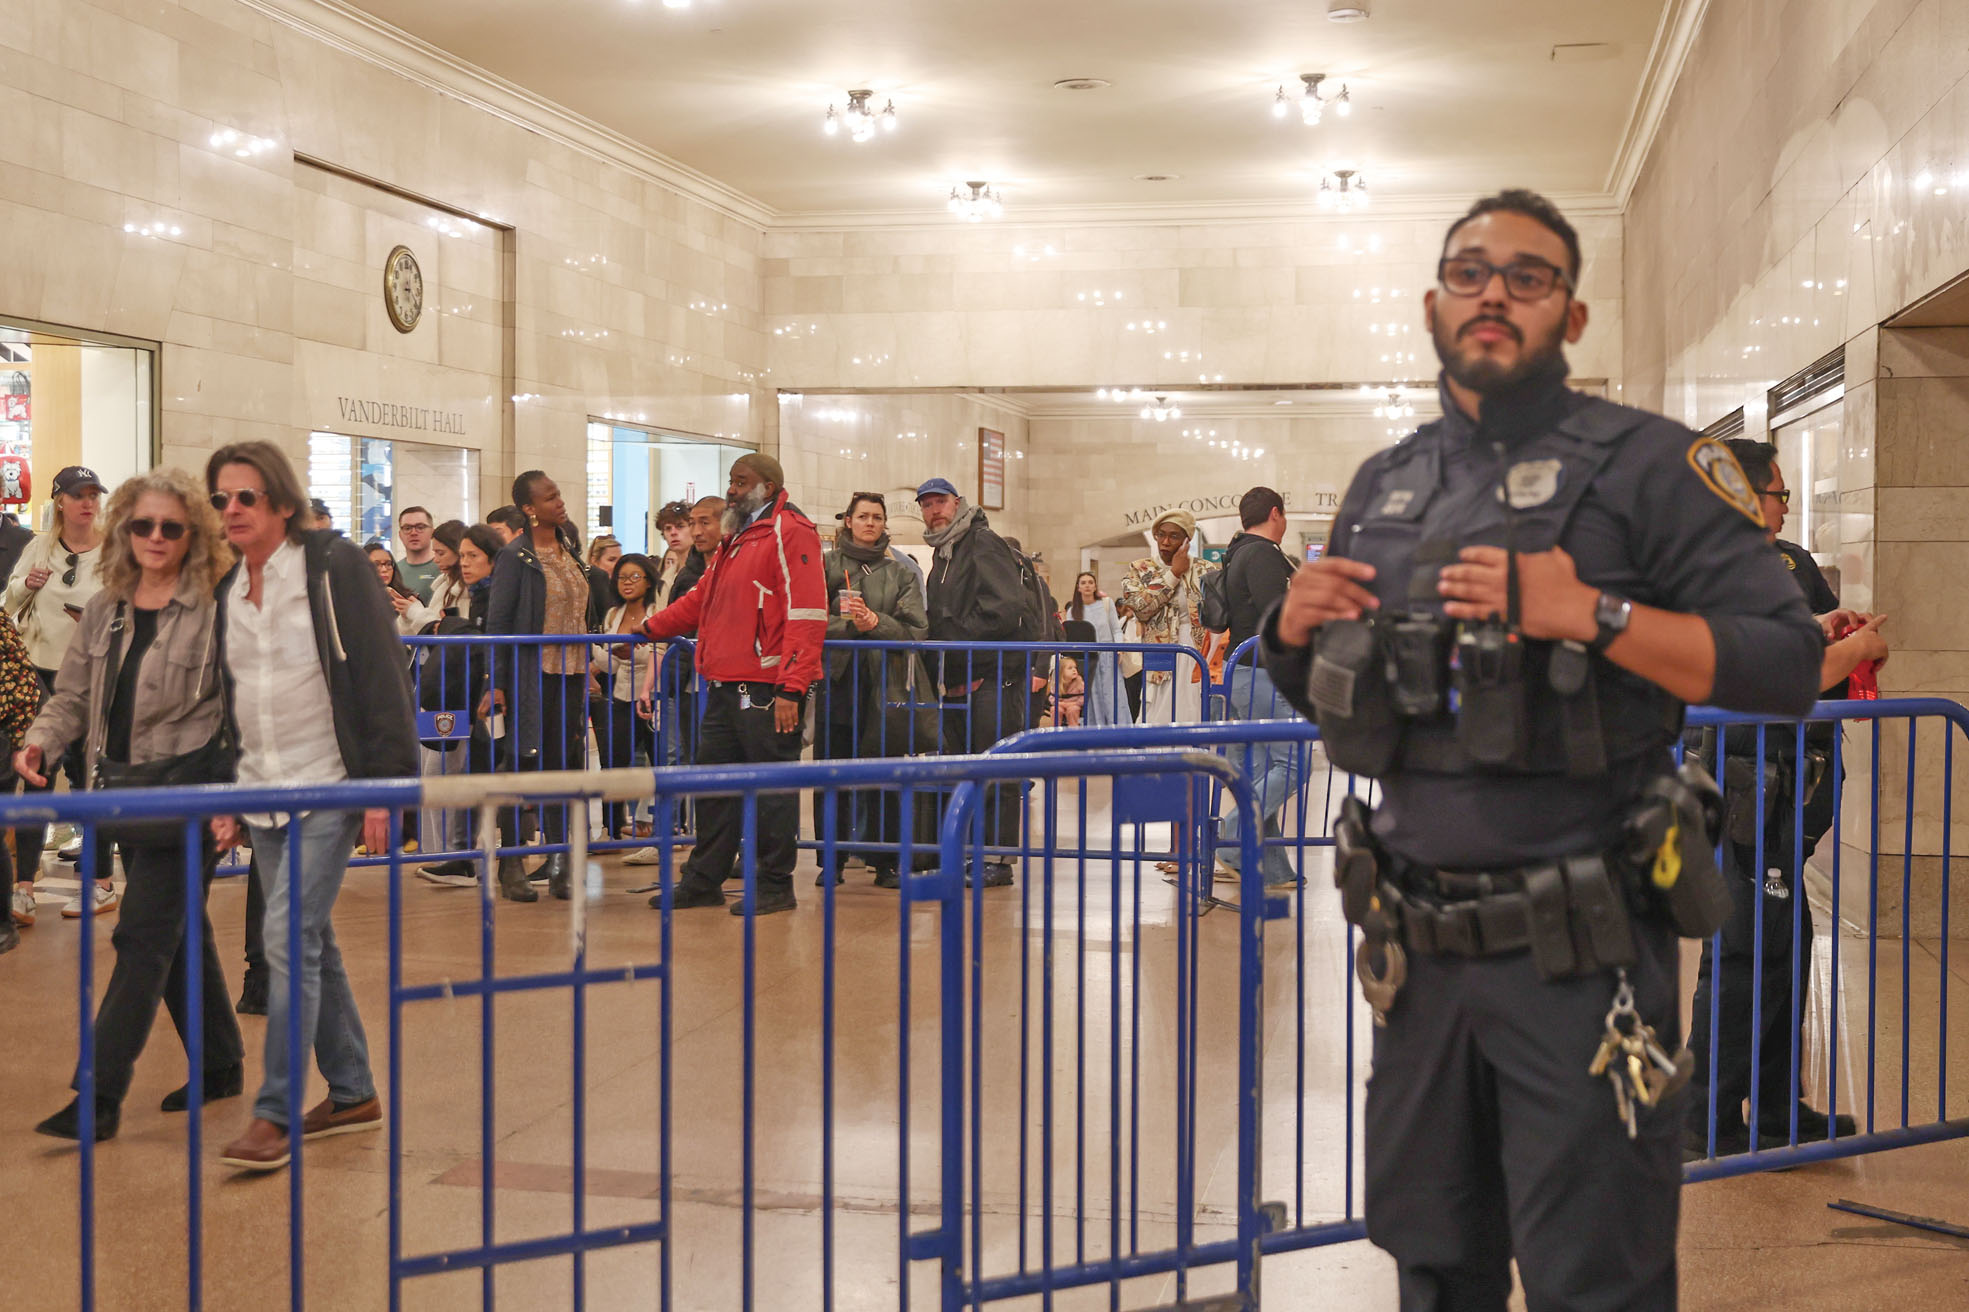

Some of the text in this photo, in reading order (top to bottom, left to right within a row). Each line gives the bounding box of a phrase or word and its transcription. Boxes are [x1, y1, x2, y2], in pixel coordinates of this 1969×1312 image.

[338, 397, 466, 435] VANDERBILT HALL
[1315, 492, 1338, 507] TR
